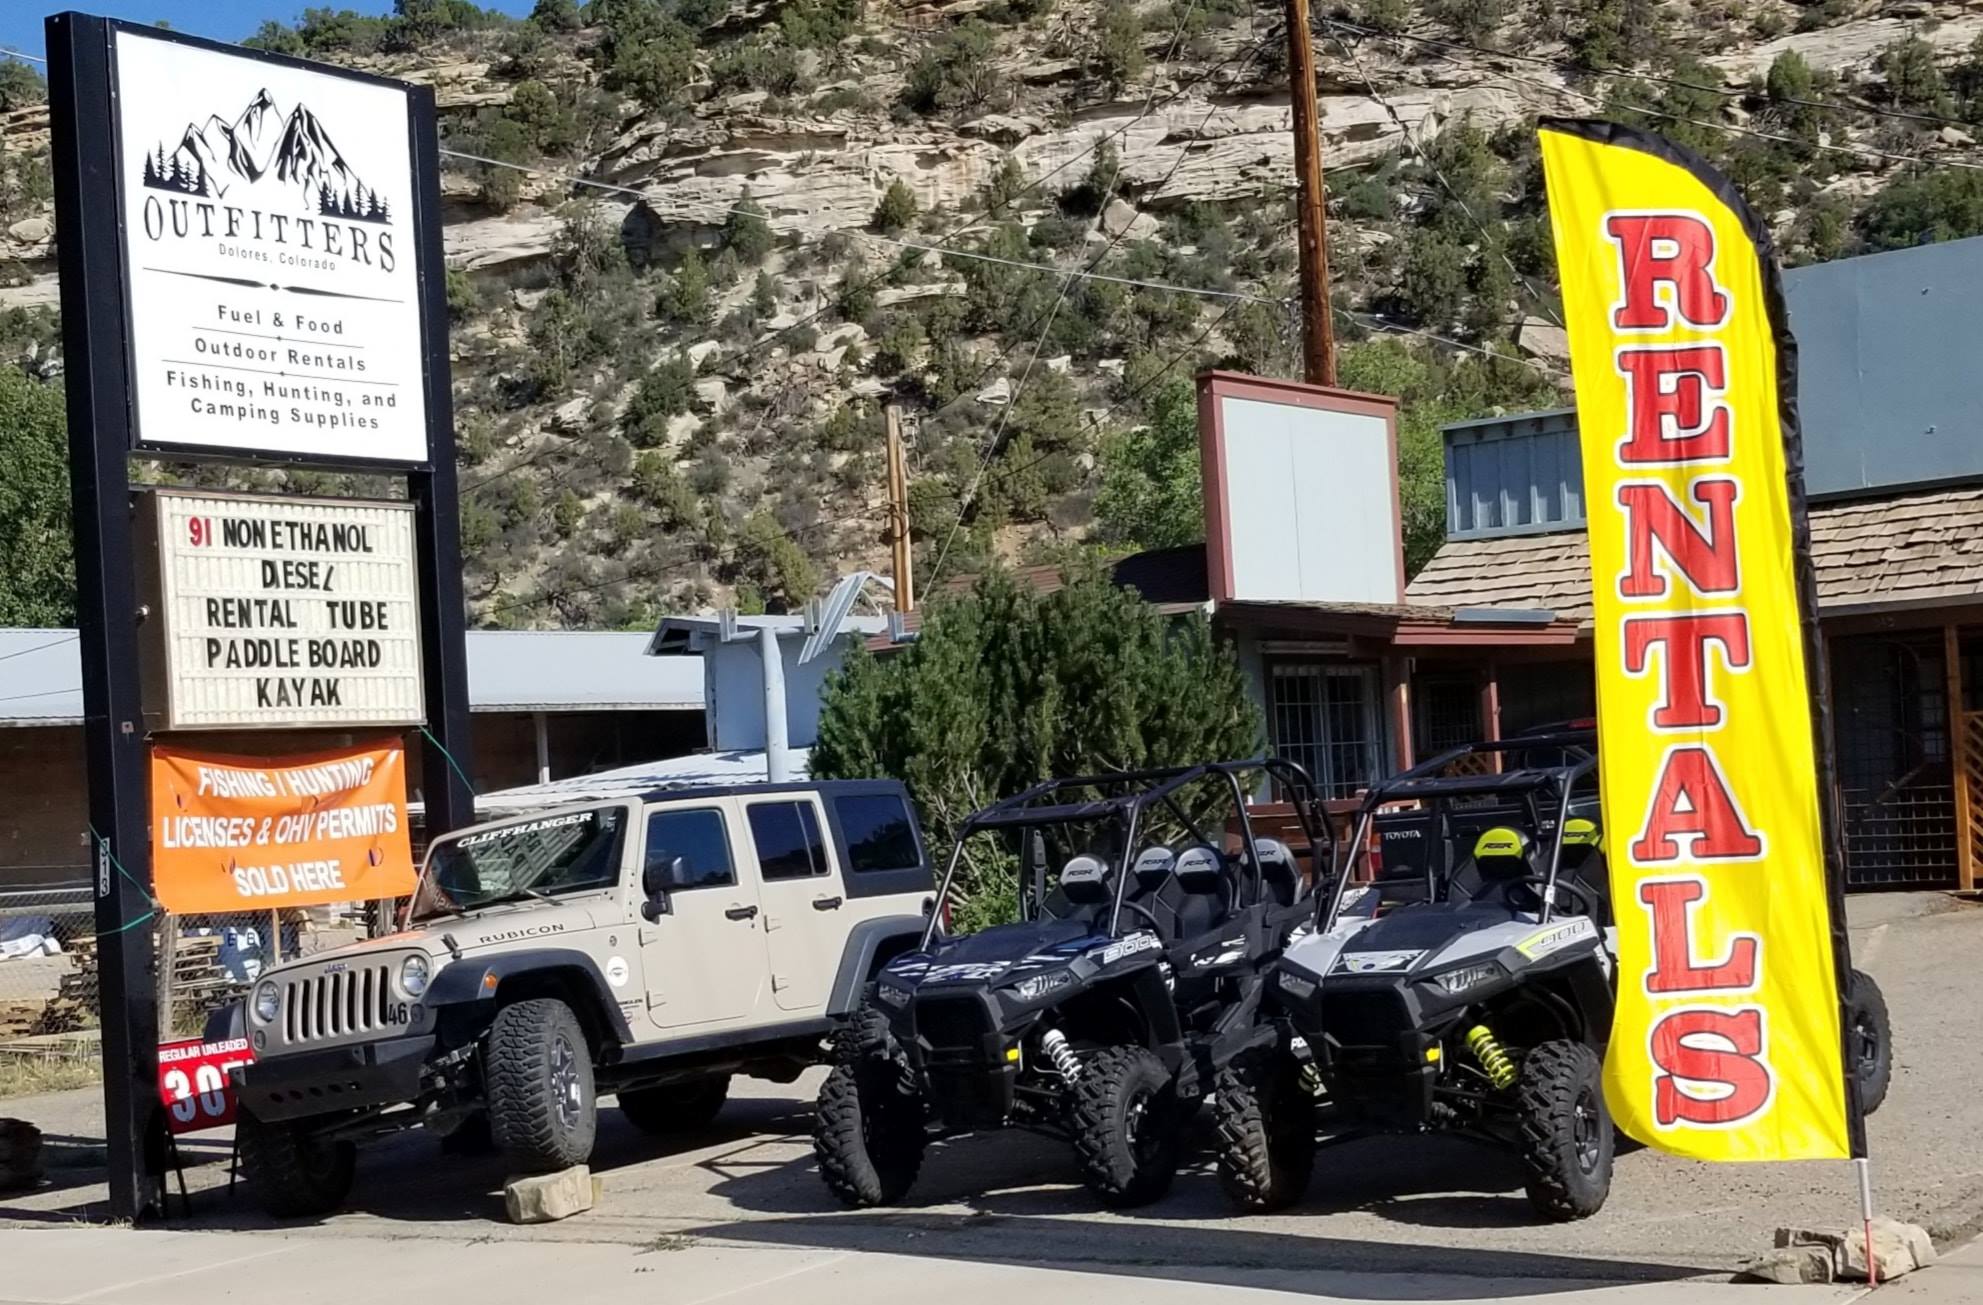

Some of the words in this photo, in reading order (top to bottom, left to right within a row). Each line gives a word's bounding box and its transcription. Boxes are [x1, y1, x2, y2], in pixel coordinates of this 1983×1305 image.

[143, 194, 396, 273] OUTFITTERS
[278, 252, 337, 271] Colorado
[217, 304, 261, 325] Fuel
[272, 312, 285, 328] &
[295, 315, 344, 334] Food
[194, 337, 278, 362] Outdoor
[287, 349, 367, 371] Rentals
[166, 370, 254, 397] Fishing,
[262, 381, 352, 407] Hunting,
[361, 393, 397, 408] and
[190, 397, 280, 425] Camping
[290, 407, 379, 430] Supplies
[188, 516, 212, 547] 91
[261, 559, 334, 592] DIESEL
[206, 598, 297, 629] RENTAL
[326, 600, 388, 630] TUBE
[206, 637, 300, 668] PADDLE
[308, 639, 381, 668] BOARD
[1607, 212, 1772, 1126] RENTALS
[256, 677, 342, 708] KAYAK
[197, 766, 275, 798] FISHING
[288, 757, 374, 796] HUNTING
[162, 815, 253, 849] LICENSES
[255, 814, 271, 845] &
[274, 811, 316, 845] OHV
[315, 803, 398, 839] PERMITS
[456, 812, 594, 849] CLIFFHANGER
[1384, 830, 1422, 841] TOYOTA
[234, 866, 290, 897] SOLD
[292, 859, 346, 892] HERE
[478, 923, 566, 945] RUBICON
[1103, 935, 1151, 964] 900
[388, 1001, 408, 1026] 46
[159, 1046, 201, 1064] REGULAR
[202, 1038, 249, 1056] UNLEADED
